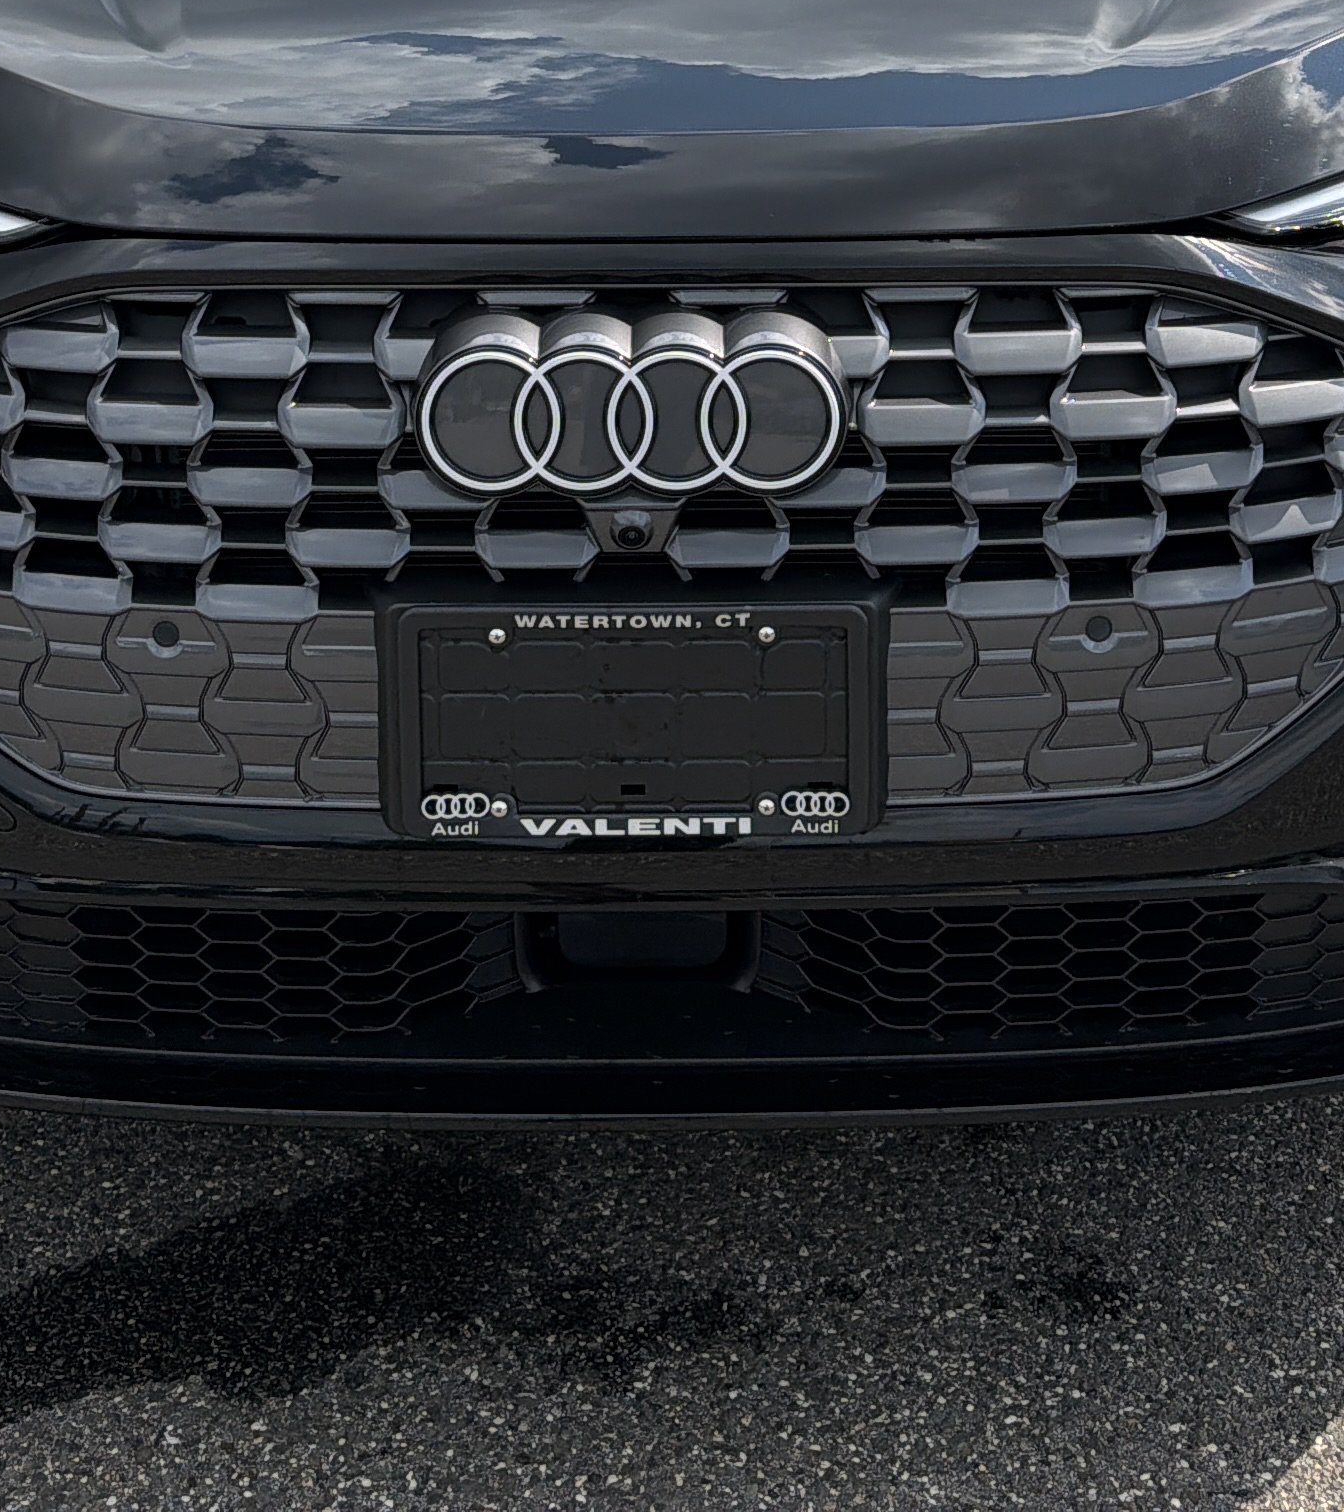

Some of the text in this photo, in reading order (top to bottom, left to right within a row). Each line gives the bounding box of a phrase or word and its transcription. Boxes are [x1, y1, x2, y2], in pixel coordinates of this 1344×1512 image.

[514, 612, 751, 630] WATERTOWN, CT
[431, 821, 480, 837] Audi
[520, 817, 753, 837] VALENTI
[790, 818, 840, 835] Audi
